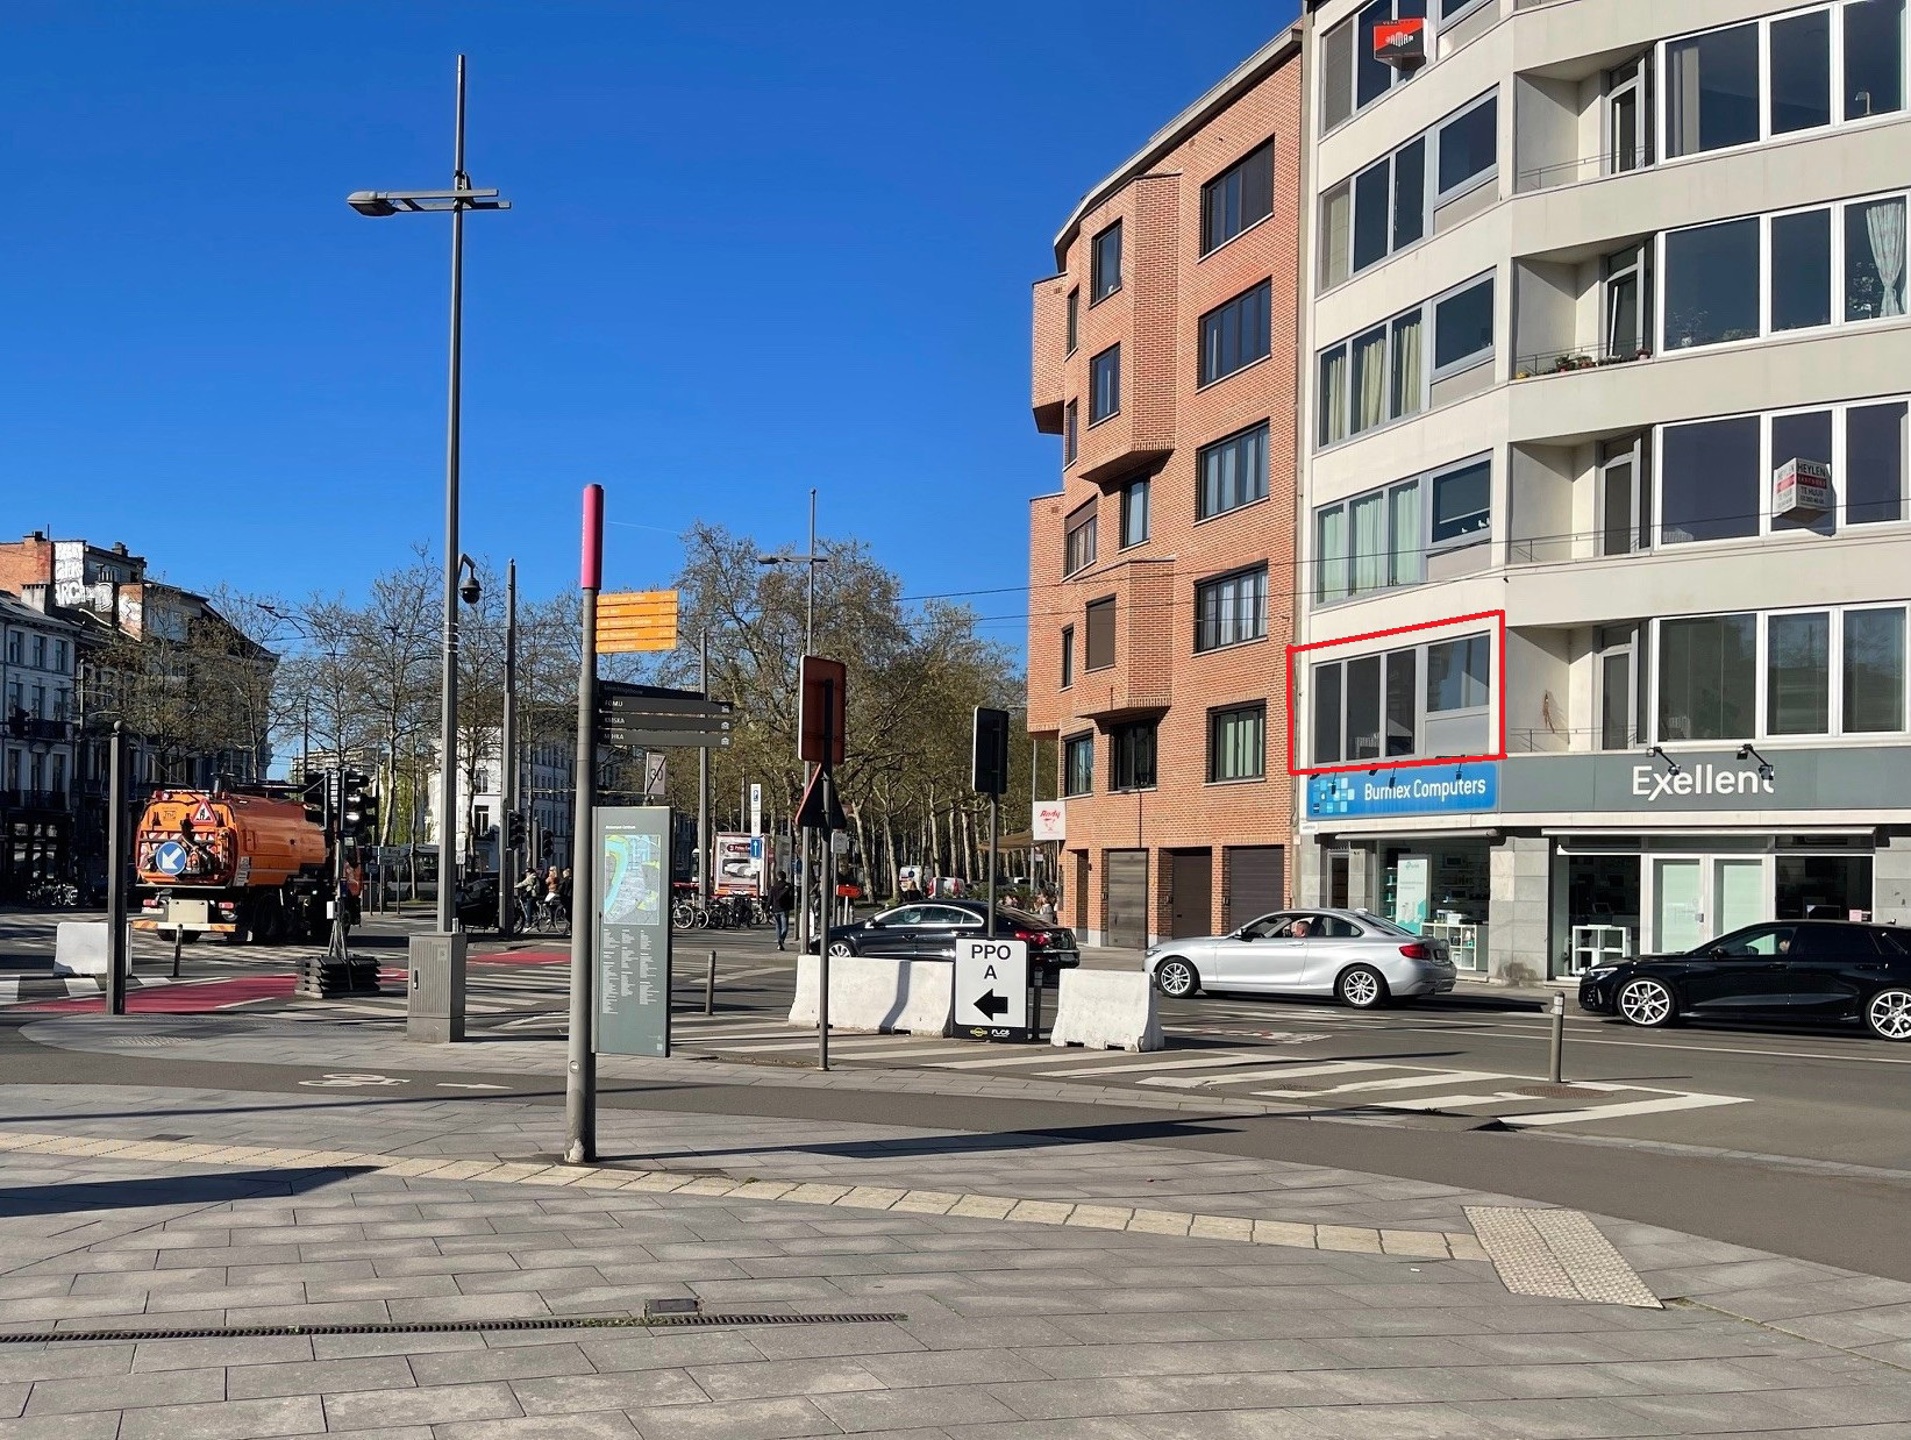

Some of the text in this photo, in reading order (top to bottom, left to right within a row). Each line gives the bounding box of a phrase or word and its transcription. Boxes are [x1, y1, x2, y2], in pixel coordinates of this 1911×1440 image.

[1796, 462, 1825, 478] HEYLEN
[650, 768, 663, 781] 30
[1414, 778, 1486, 802] Computers
[971, 944, 1011, 960] PPO
[984, 965, 997, 979] A
